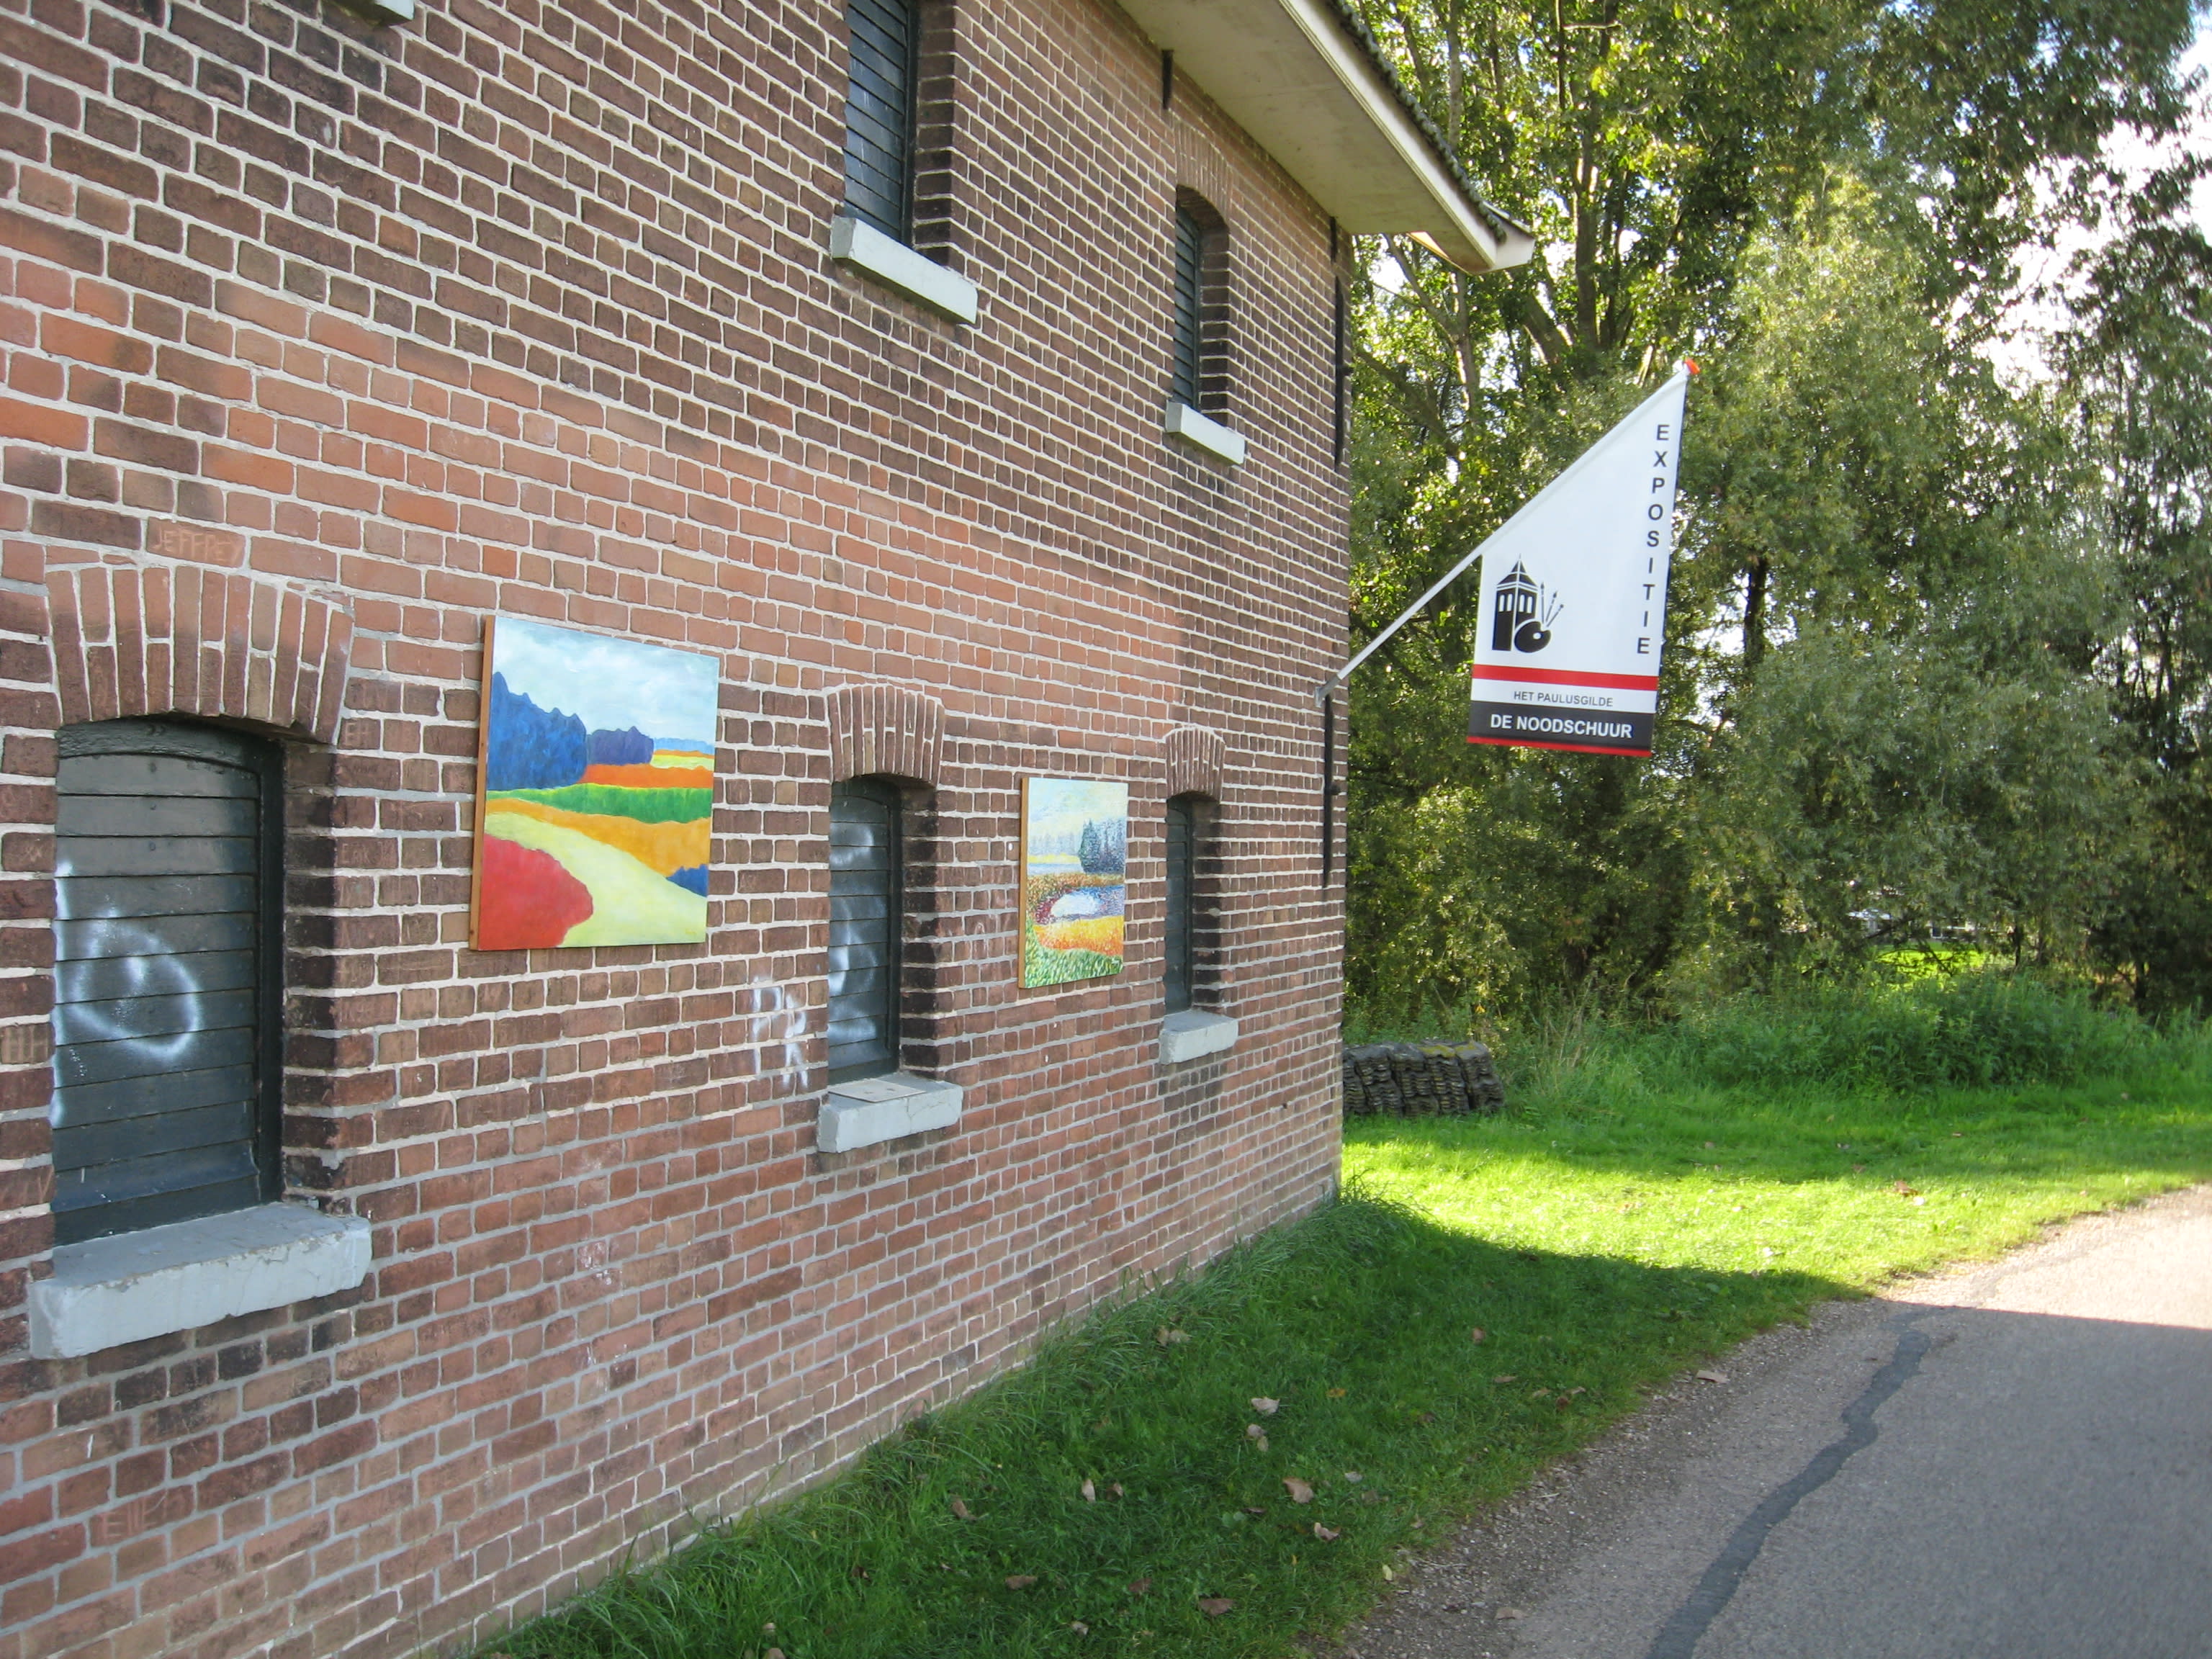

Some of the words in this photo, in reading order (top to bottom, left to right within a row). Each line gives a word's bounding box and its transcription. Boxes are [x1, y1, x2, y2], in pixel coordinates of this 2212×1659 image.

[1637, 423, 1670, 655] EXPOSITIE
[1513, 690, 1534, 702] HET
[1537, 692, 1614, 707] PAULUSGILDE
[1490, 714, 1513, 729] DE
[1516, 716, 1633, 739] NOODSCHUUR
